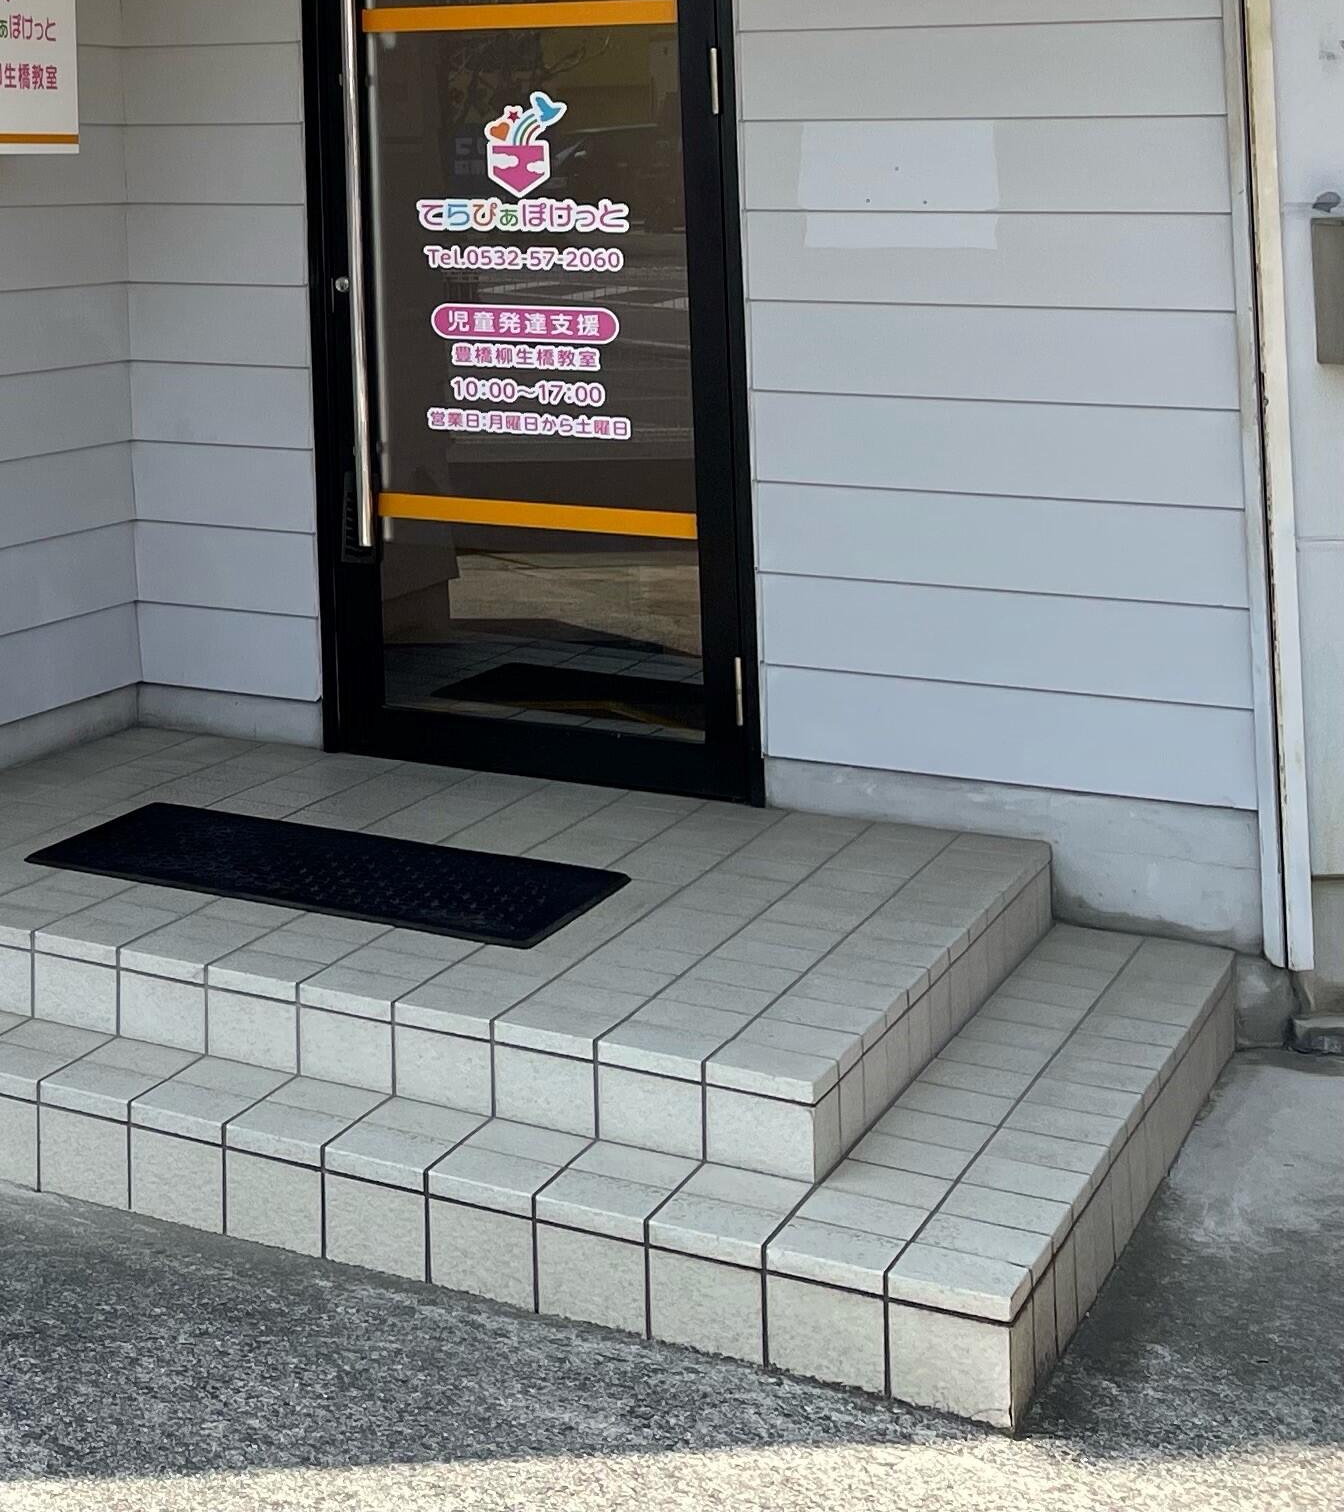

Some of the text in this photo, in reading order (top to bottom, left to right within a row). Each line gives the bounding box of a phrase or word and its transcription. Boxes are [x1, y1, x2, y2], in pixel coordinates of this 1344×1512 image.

[420, 201, 626, 230] てらぴぁぽけっと
[427, 248, 621, 270] Tel.0532-57-2060
[447, 309, 601, 338] 児童発達支援
[454, 345, 599, 369] 豊橋柳生橋教室
